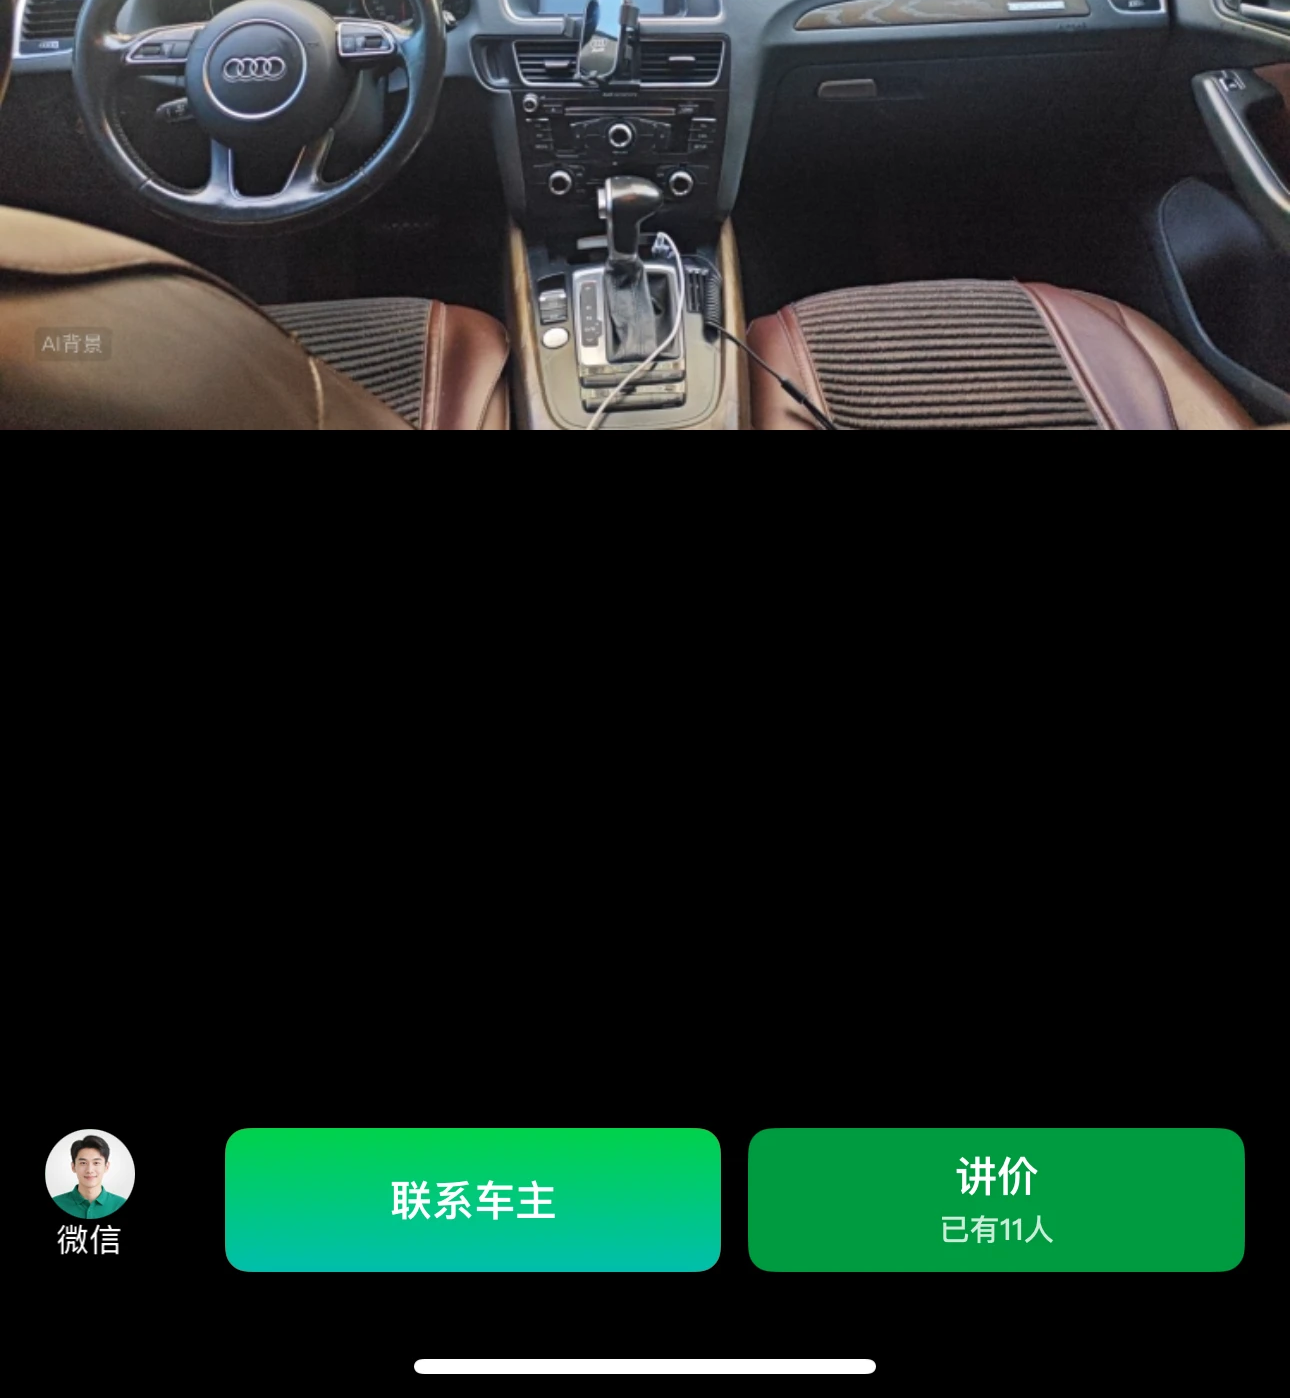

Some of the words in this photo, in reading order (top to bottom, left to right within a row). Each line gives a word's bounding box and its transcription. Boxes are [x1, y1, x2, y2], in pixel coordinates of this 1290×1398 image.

[956, 1156, 1038, 1197] 讲价
[391, 1181, 555, 1220] 联系车主
[57, 1224, 122, 1255] 微信
[941, 1215, 1054, 1244] 已有11人
